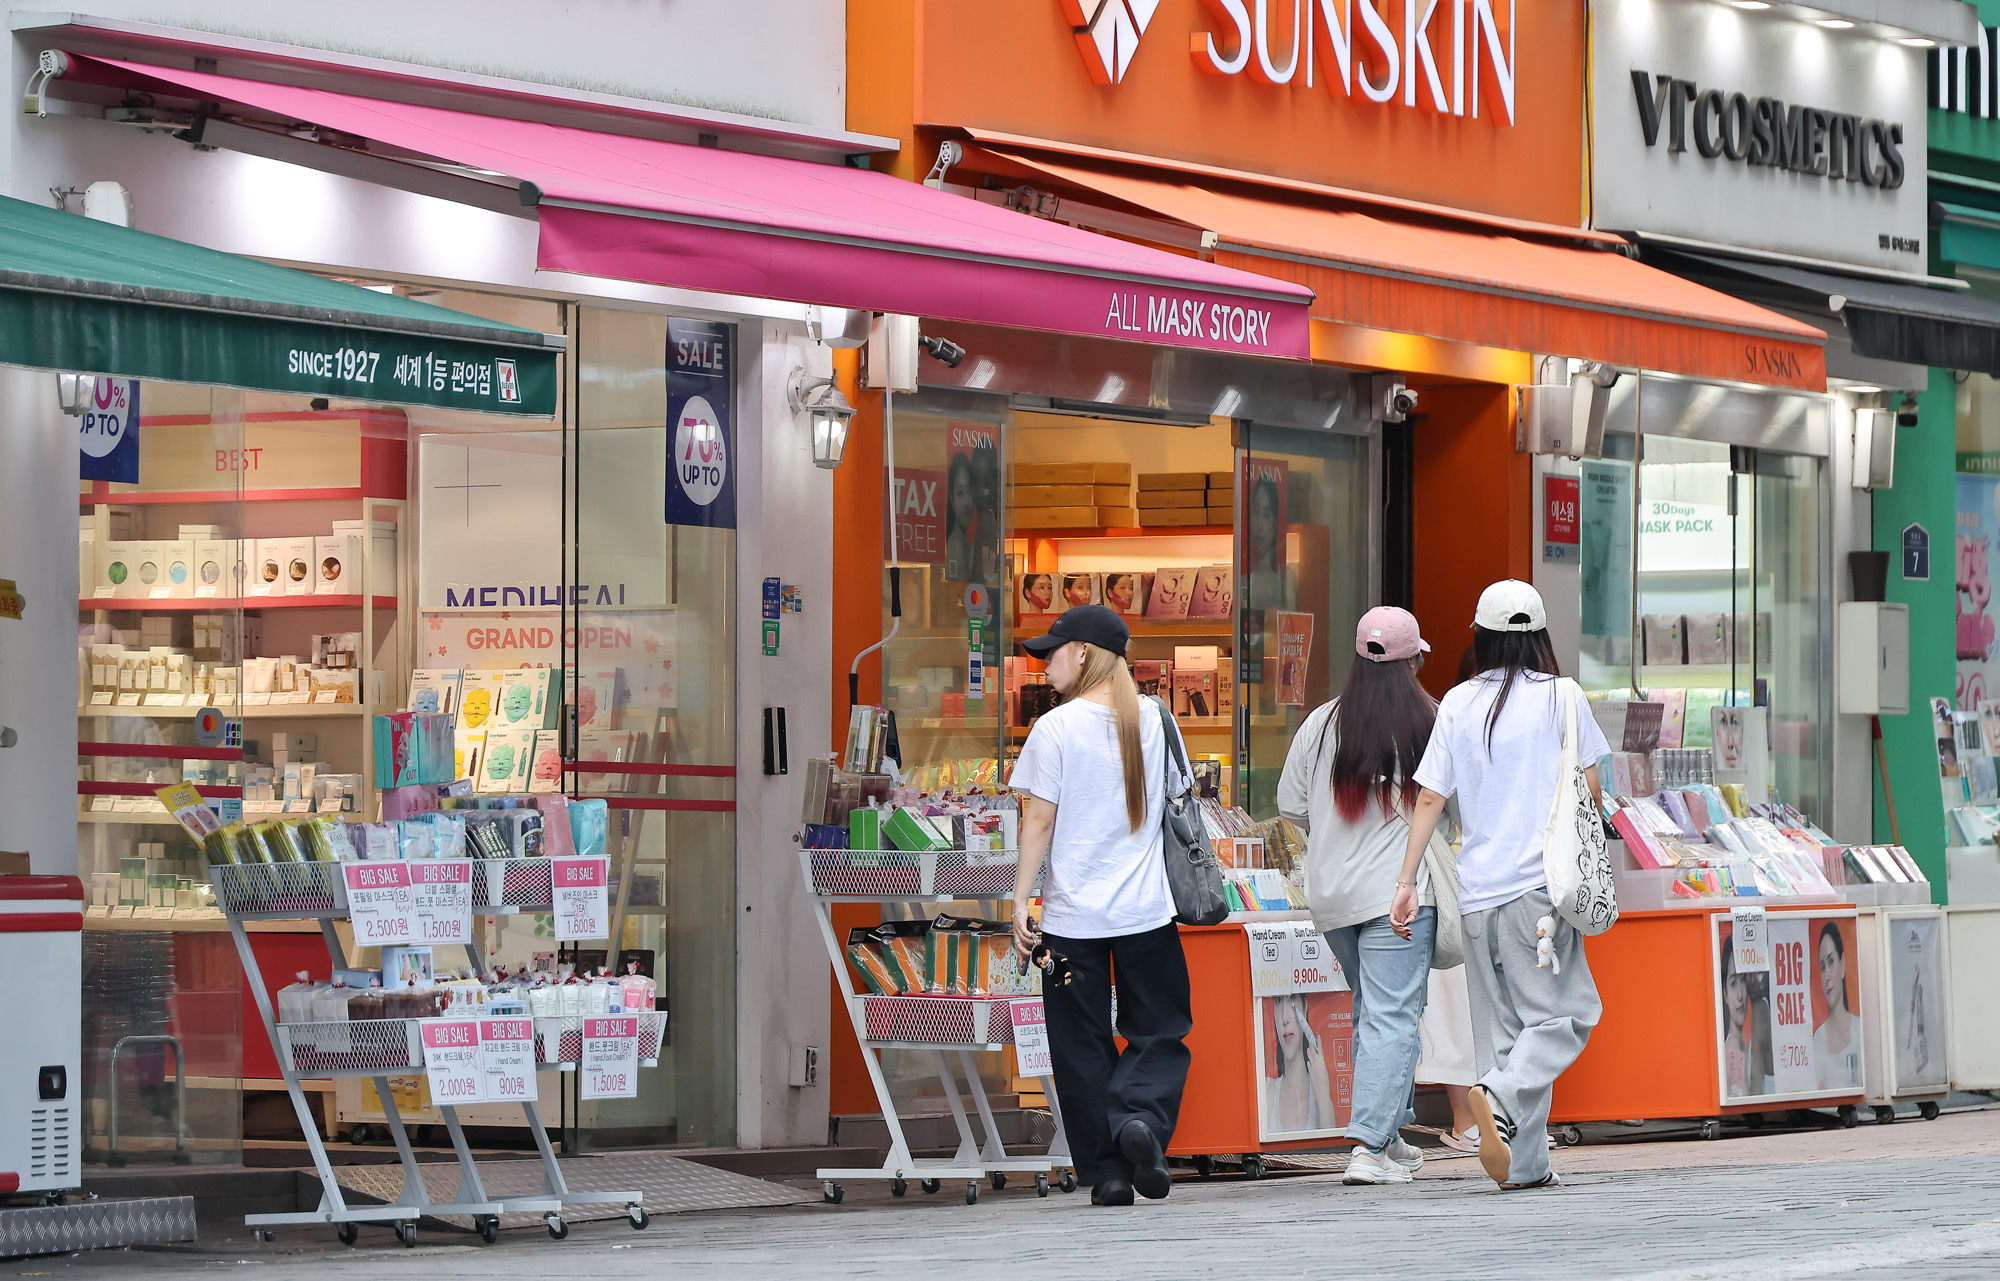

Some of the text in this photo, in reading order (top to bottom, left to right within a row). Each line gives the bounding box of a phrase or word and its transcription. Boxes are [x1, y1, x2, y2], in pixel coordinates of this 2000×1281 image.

[1105, 292, 1271, 347] ALL MASK STORY
[677, 338, 723, 370] SALE
[1745, 344, 1801, 379] SUNSKIN
[288, 347, 491, 396] SINCE 1927 세계 1등 편의점
[98, 413, 119, 436] TO
[683, 417, 723, 463] 70%
[952, 428, 993, 449] SUNSKIN
[215, 448, 263, 472] BEST
[683, 464, 720, 487] UP TO
[1245, 463, 1282, 483] SUNSKIN
[893, 477, 937, 518] TAX
[1551, 500, 1574, 523] 에스원
[1676, 519, 1714, 533] PACK
[1912, 551, 1920, 573] 7
[466, 627, 632, 650] GRAND OPEN
[406, 769, 416, 780] OUT
[360, 867, 399, 885] BIG SALE
[423, 865, 460, 881] BIG SALE
[566, 867, 594, 880] BIG SALE
[374, 890, 394, 902] 마스크
[395, 890, 408, 900] 1EA
[436, 896, 453, 907] 마스크
[583, 890, 597, 899] 마스크
[576, 904, 585, 912] 1EA
[1735, 912, 1763, 923] Hand Cream
[366, 918, 409, 938] 2,500원
[422, 919, 461, 939] 1,500원
[567, 918, 596, 935] 1,600원
[1252, 929, 1287, 941] Hand Cream
[1294, 927, 1305, 938] Sun
[1265, 946, 1275, 957] 1ea
[1305, 945, 1316, 955] 3ea
[1775, 941, 1803, 986] BIG
[1253, 969, 1278, 992] 1,000
[1293, 967, 1318, 988] 9,900
[1020, 1006, 1045, 1021] BIG SAL
[1776, 992, 1806, 1026] SALE
[434, 1026, 469, 1043] BIG SALE
[491, 1021, 524, 1038] BIG SALE
[595, 1020, 627, 1036] BIG SALE
[511, 1042, 521, 1052] 크림
[521, 1042, 530, 1051] 1EA
[1788, 1045, 1809, 1067] 70%
[439, 1077, 476, 1098] 2,000원
[499, 1076, 525, 1095] 900원
[593, 1073, 626, 1093] 1,500원
